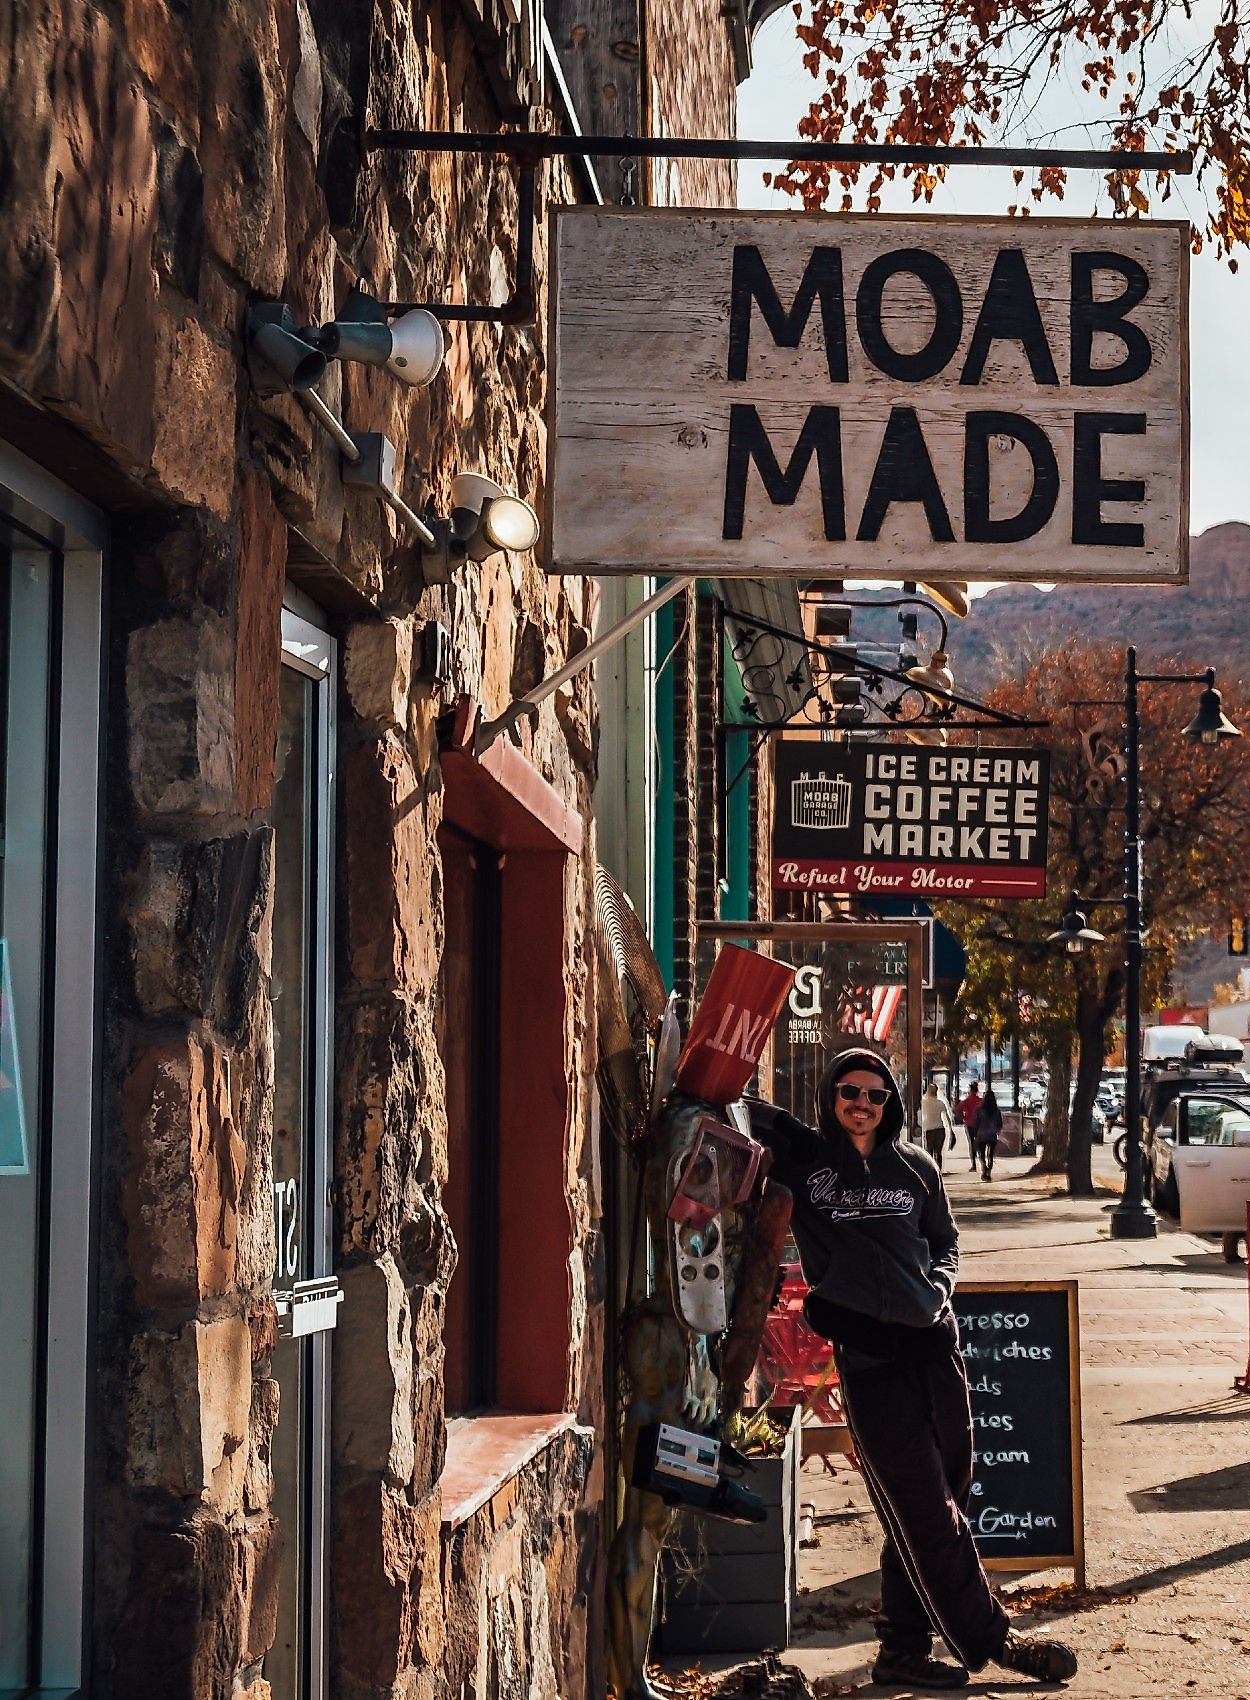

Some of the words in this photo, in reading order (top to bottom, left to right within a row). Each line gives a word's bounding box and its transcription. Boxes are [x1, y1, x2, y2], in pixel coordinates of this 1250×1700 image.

[727, 245, 1153, 386] MOAB
[722, 404, 1147, 546] MADE
[865, 753, 917, 780] ICE
[928, 756, 1039, 785] CREAM
[803, 801, 838, 810] GARAGE
[804, 791, 839, 802] MOAB
[864, 784, 1038, 824] COFFEE
[863, 822, 1037, 860] MARKET
[778, 861, 847, 887] Refuel
[853, 864, 904, 892] Your
[910, 867, 974, 889] Motor
[705, 1003, 771, 1064] TNT
[806, 1167, 912, 1208] Vancuver
[978, 1507, 1057, 1533] Garden
